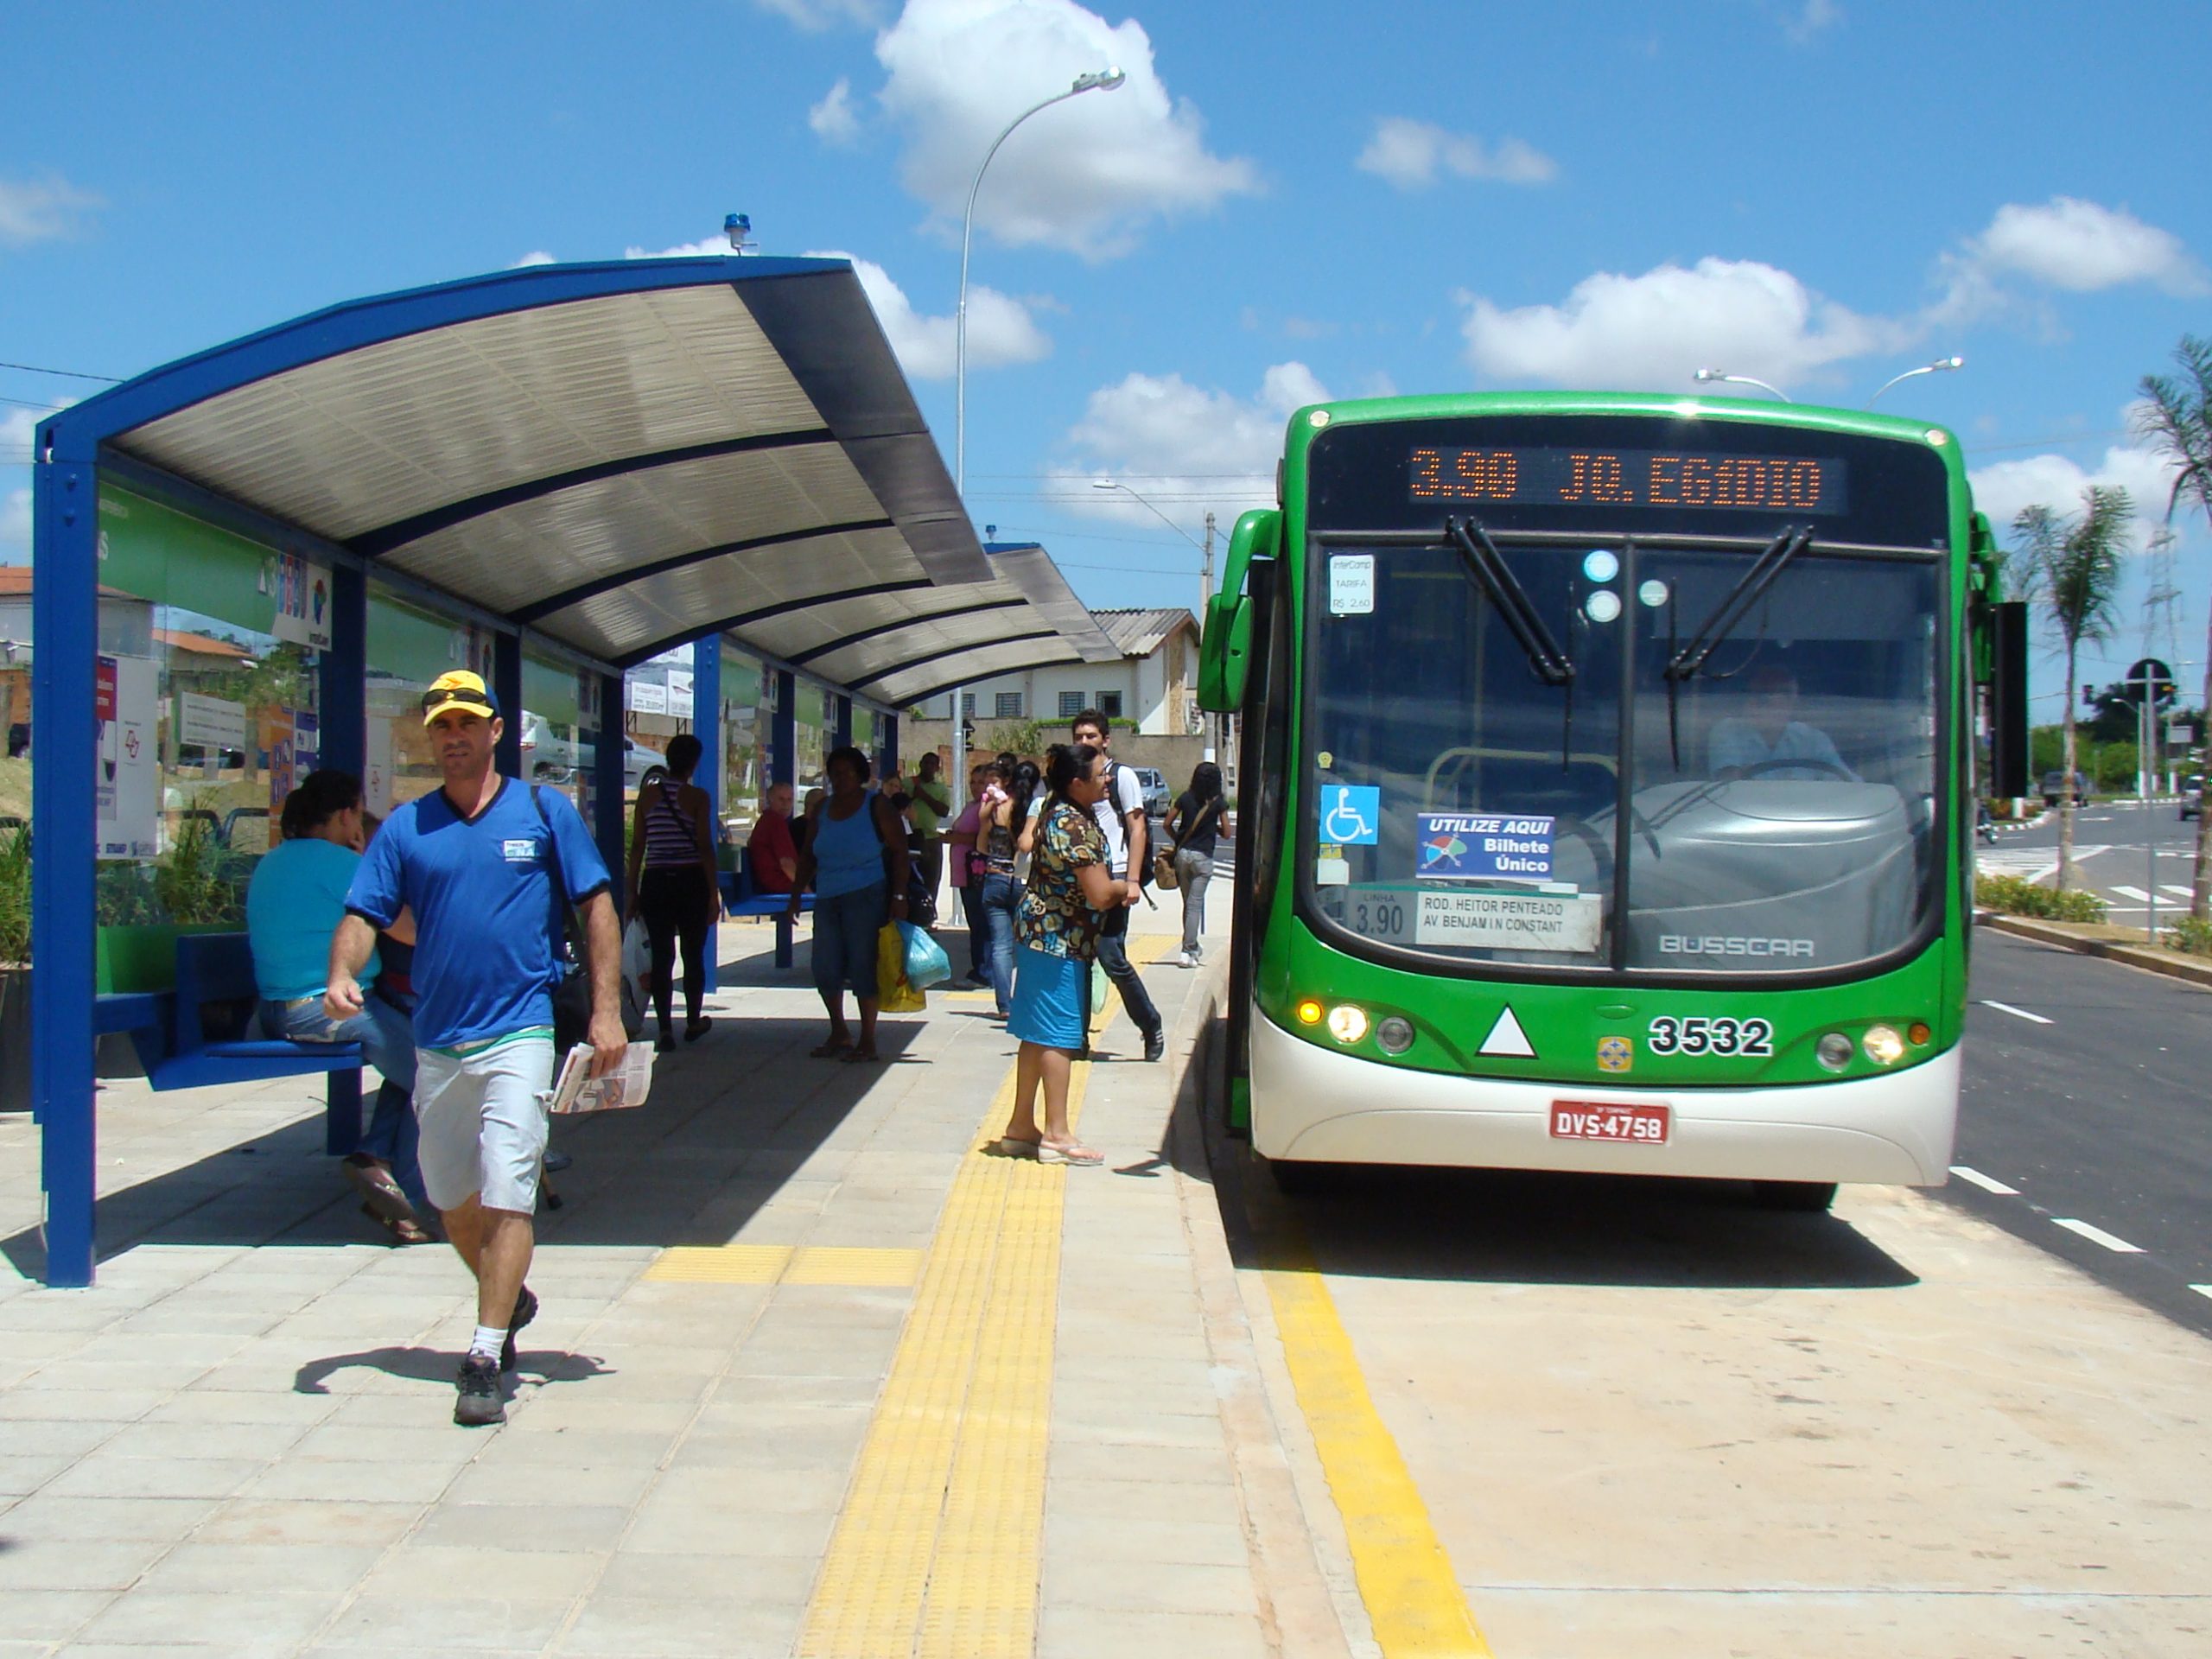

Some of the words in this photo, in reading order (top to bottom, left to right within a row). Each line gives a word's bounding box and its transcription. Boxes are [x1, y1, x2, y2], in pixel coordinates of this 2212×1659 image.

[1410, 449, 1517, 499] 3.90
[1335, 580, 1368, 588] TARIFA
[1428, 818, 1502, 834] UTILIZE
[1502, 820, 1551, 836] AQUI
[1484, 838, 1550, 854] Bilhete
[1495, 854, 1549, 873] Único
[1363, 893, 1396, 903] LINHA
[1424, 897, 1452, 911] ROD.
[1455, 899, 1499, 913] HEITOR
[1501, 901, 1564, 916] PENTEADO
[1356, 903, 1404, 936] 3.90
[1423, 914, 1439, 927] AV
[1505, 918, 1564, 933] CONSTANT
[1659, 934, 1815, 957] BUSSCAR
[1648, 1015, 1773, 1058] 3532
